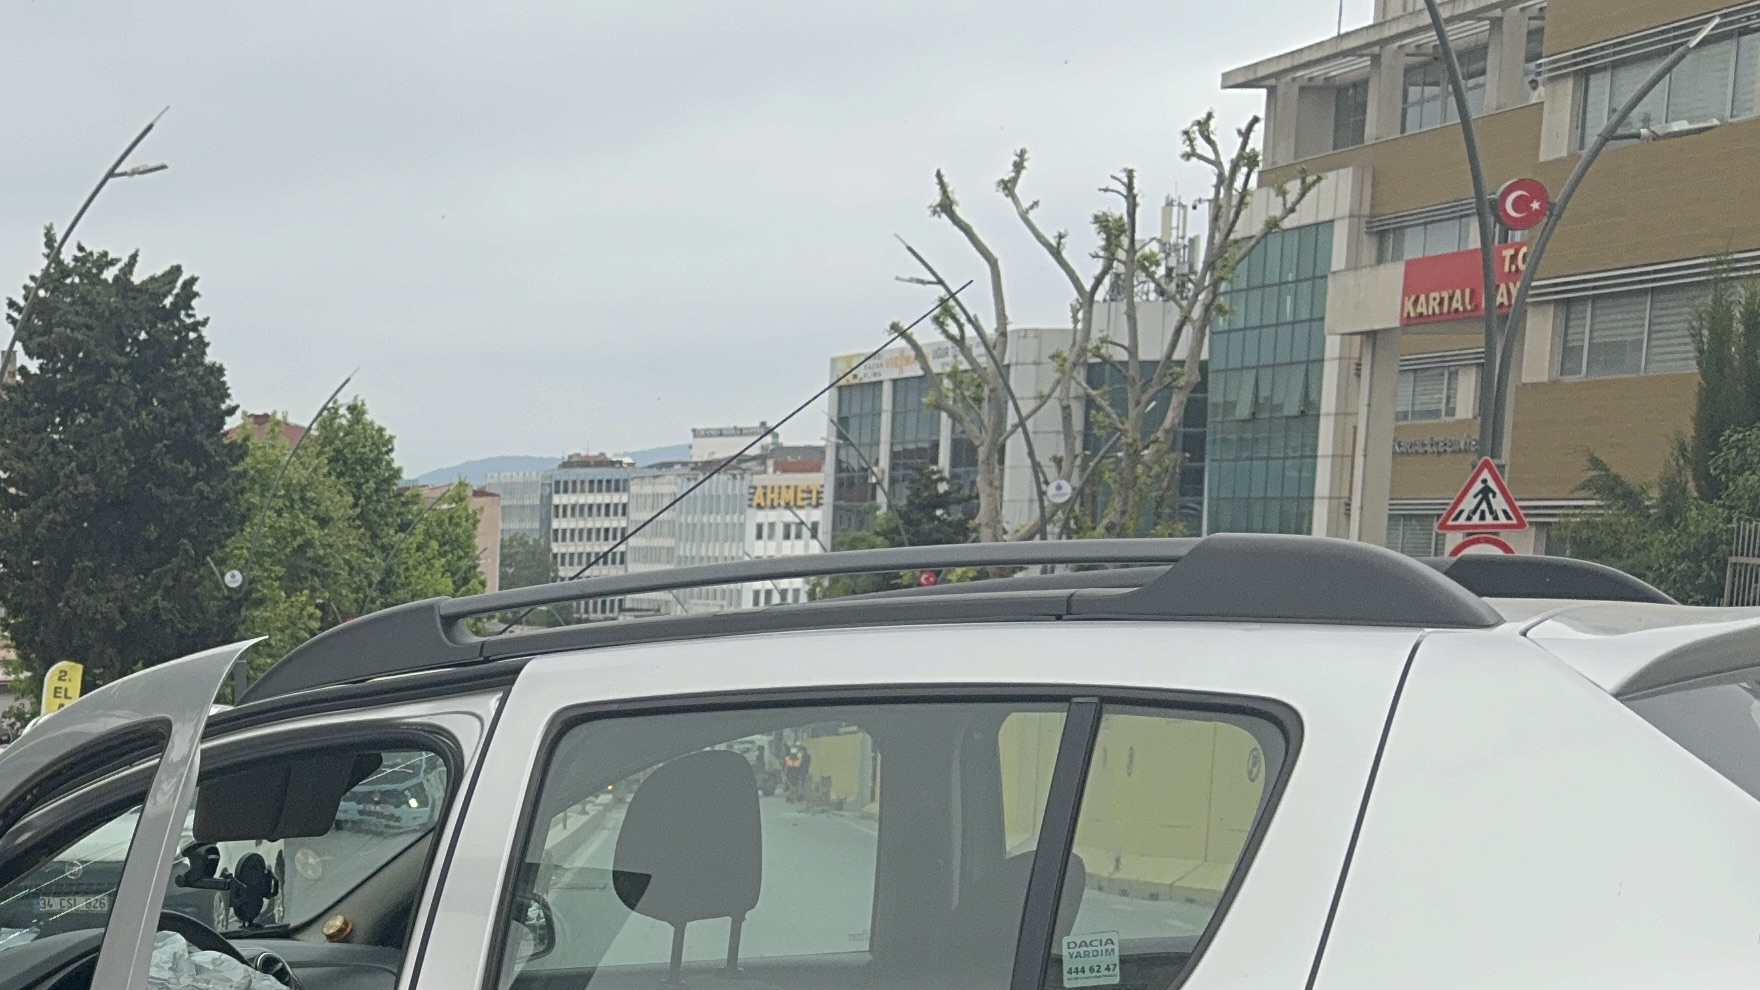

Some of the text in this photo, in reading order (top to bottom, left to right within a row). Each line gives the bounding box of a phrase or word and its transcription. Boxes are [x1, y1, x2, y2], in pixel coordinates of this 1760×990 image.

[1403, 287, 1473, 318] KARTAL
[752, 484, 820, 507] AHMET
[57, 669, 72, 682] 2.
[53, 686, 72, 700] EL
[1066, 937, 1115, 950] DACIA
[1068, 947, 1116, 960] YARDIM
[1066, 963, 1118, 976] 444 62 47
